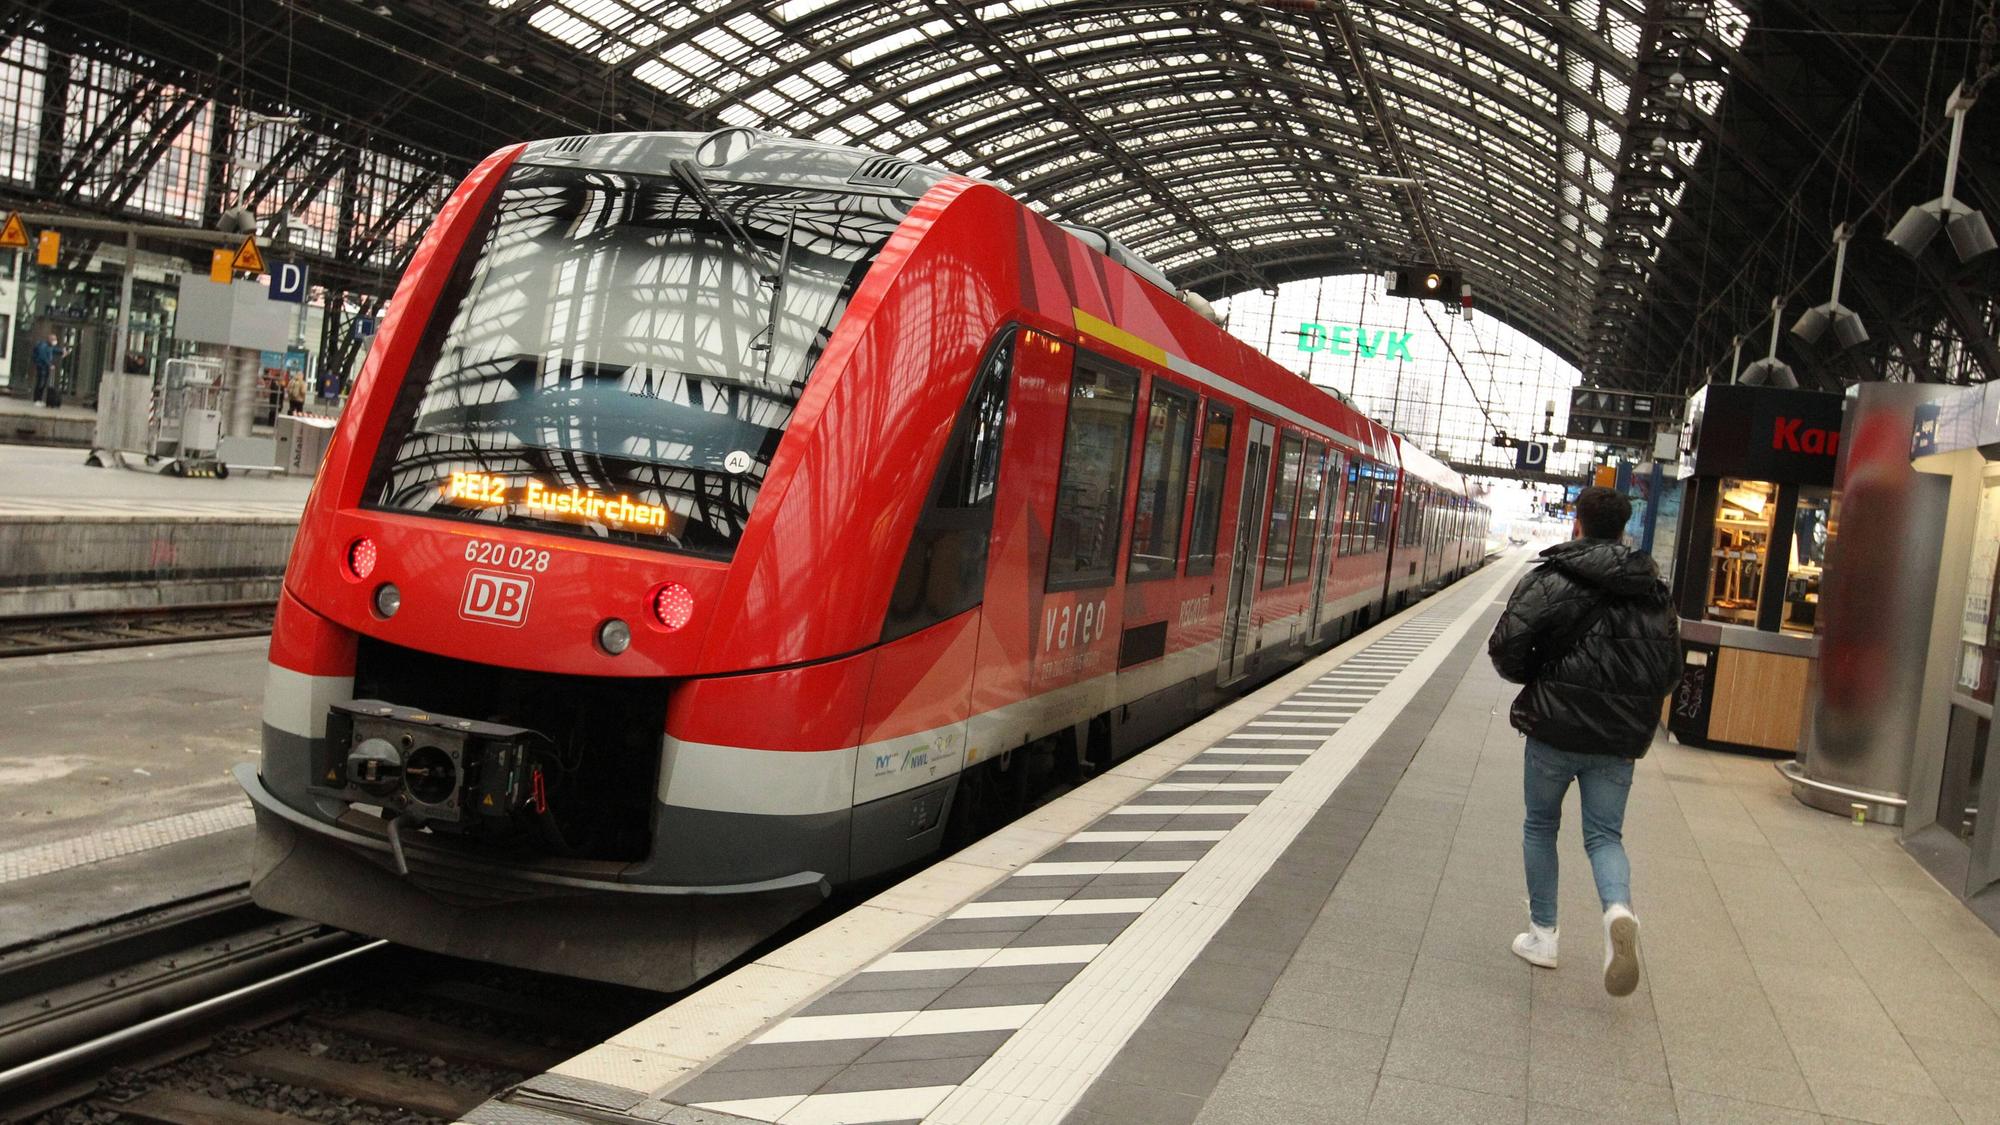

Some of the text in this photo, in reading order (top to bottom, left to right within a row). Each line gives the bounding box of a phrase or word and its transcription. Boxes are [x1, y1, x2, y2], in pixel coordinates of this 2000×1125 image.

[280, 264, 300, 294] D
[1298, 322, 1414, 362] DEVK
[729, 456, 744, 468] AL
[1525, 441, 1544, 465] D
[451, 471, 666, 526] RE12 Euskirchen
[465, 540, 550, 573] 620 028
[470, 577, 523, 617] DB
[1046, 600, 1106, 652] vareo
[911, 752, 928, 769] NWL
